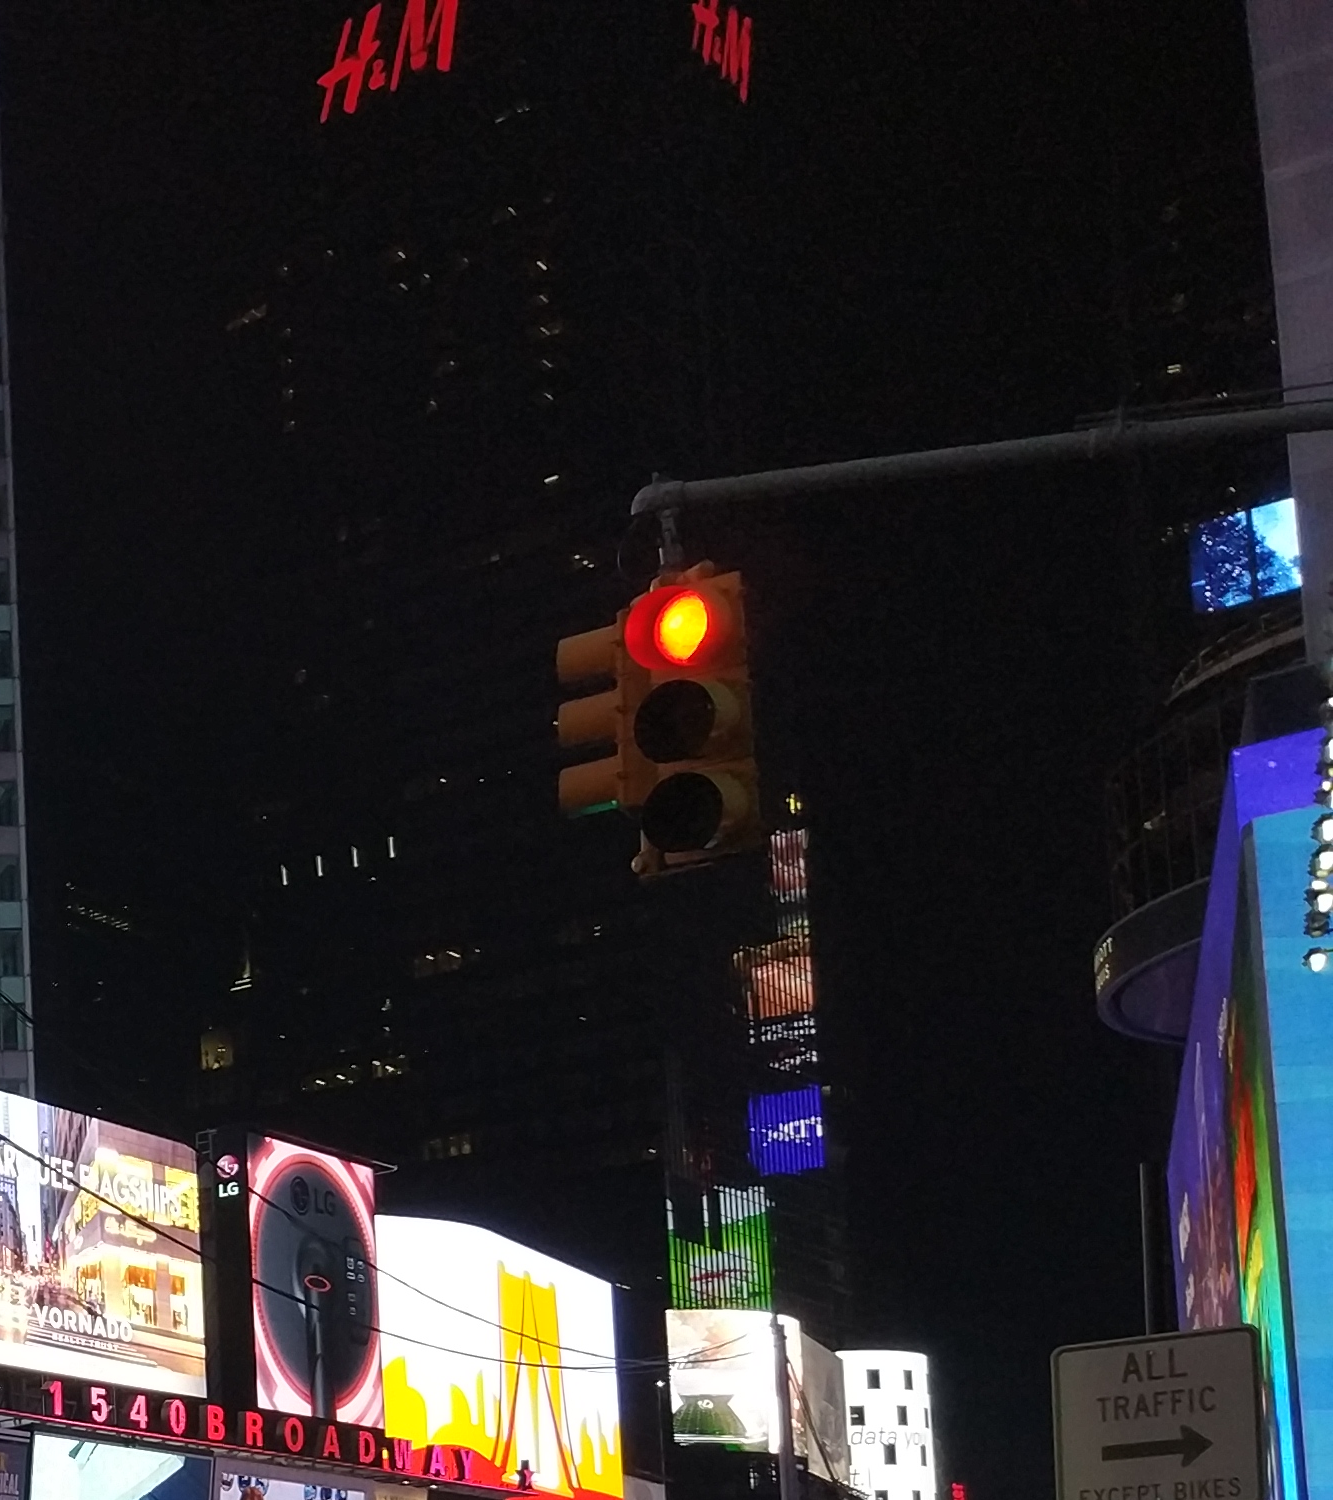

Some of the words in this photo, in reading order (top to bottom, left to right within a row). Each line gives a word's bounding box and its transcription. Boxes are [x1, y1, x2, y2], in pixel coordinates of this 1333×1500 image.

[317, 0, 457, 124] H&M
[691, 0, 752, 104] H&M
[219, 1182, 239, 1198] LG
[35, 1304, 133, 1344] VORNADO
[1122, 1348, 1188, 1384] ALL
[1096, 1386, 1217, 1422] TRAFFIC
[47, 1380, 188, 1435] 1540
[206, 1403, 475, 1480] BROADWAY
[851, 1428, 897, 1446] data
[1174, 1477, 1242, 1500] BIKES
